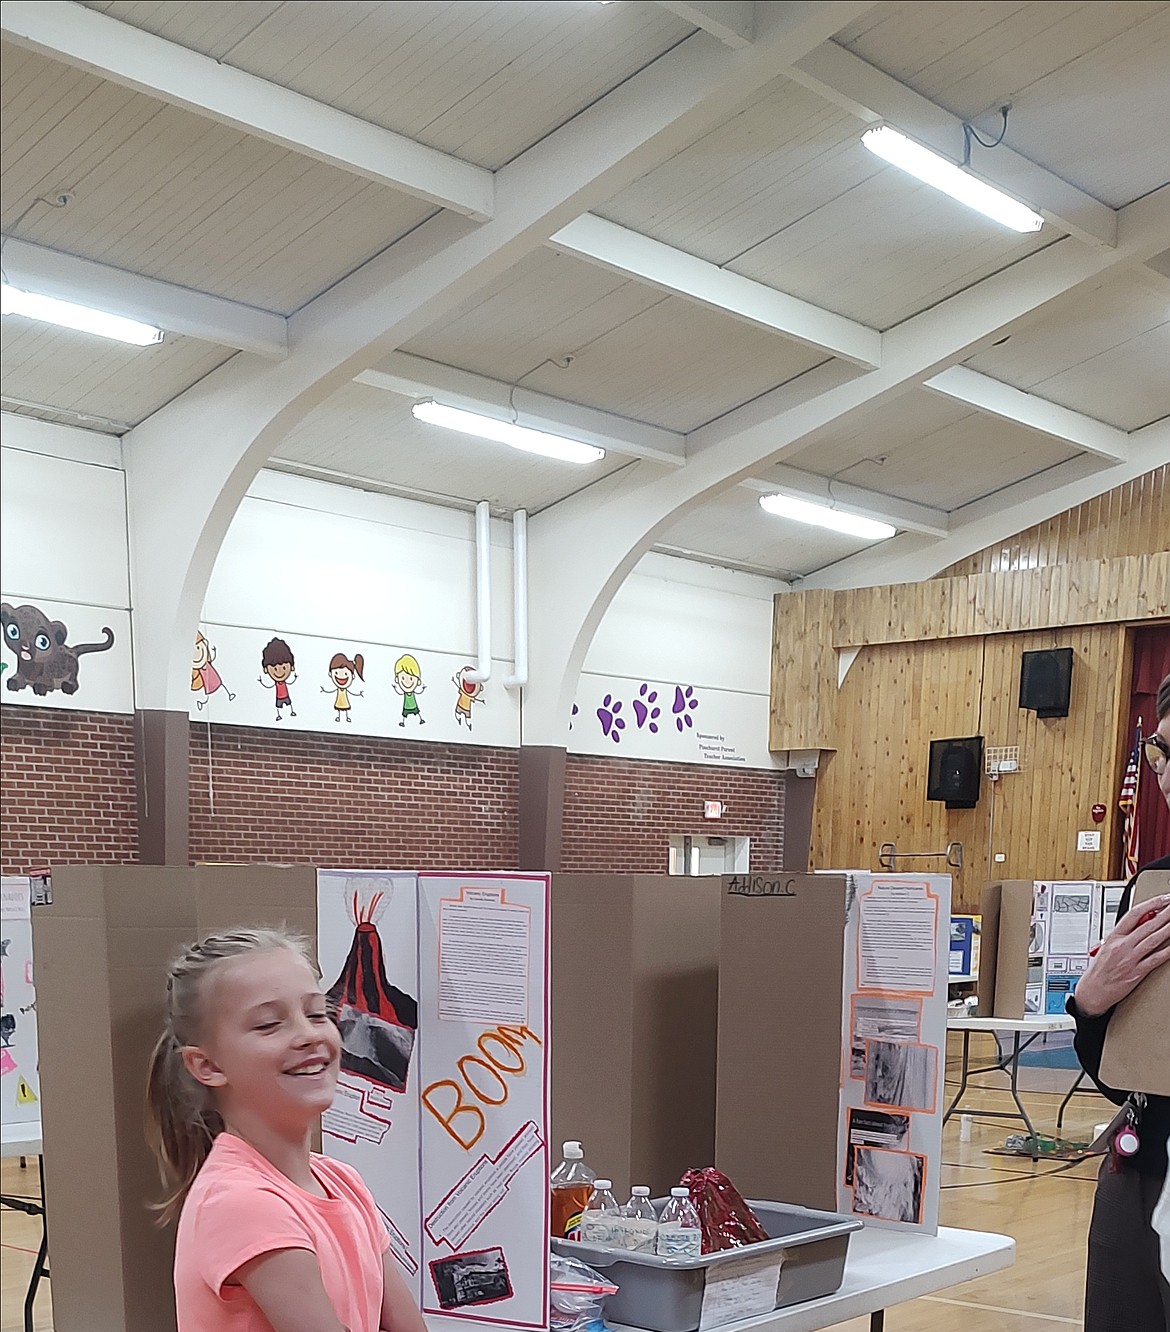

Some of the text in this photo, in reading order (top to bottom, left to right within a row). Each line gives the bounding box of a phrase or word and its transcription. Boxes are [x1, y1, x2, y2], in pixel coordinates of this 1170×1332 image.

[697, 732, 719, 740] Sponsored
[421, 1026, 542, 1150] BOOM
[428, 1159, 488, 1228] Destruction from Volcanic Eruptions
